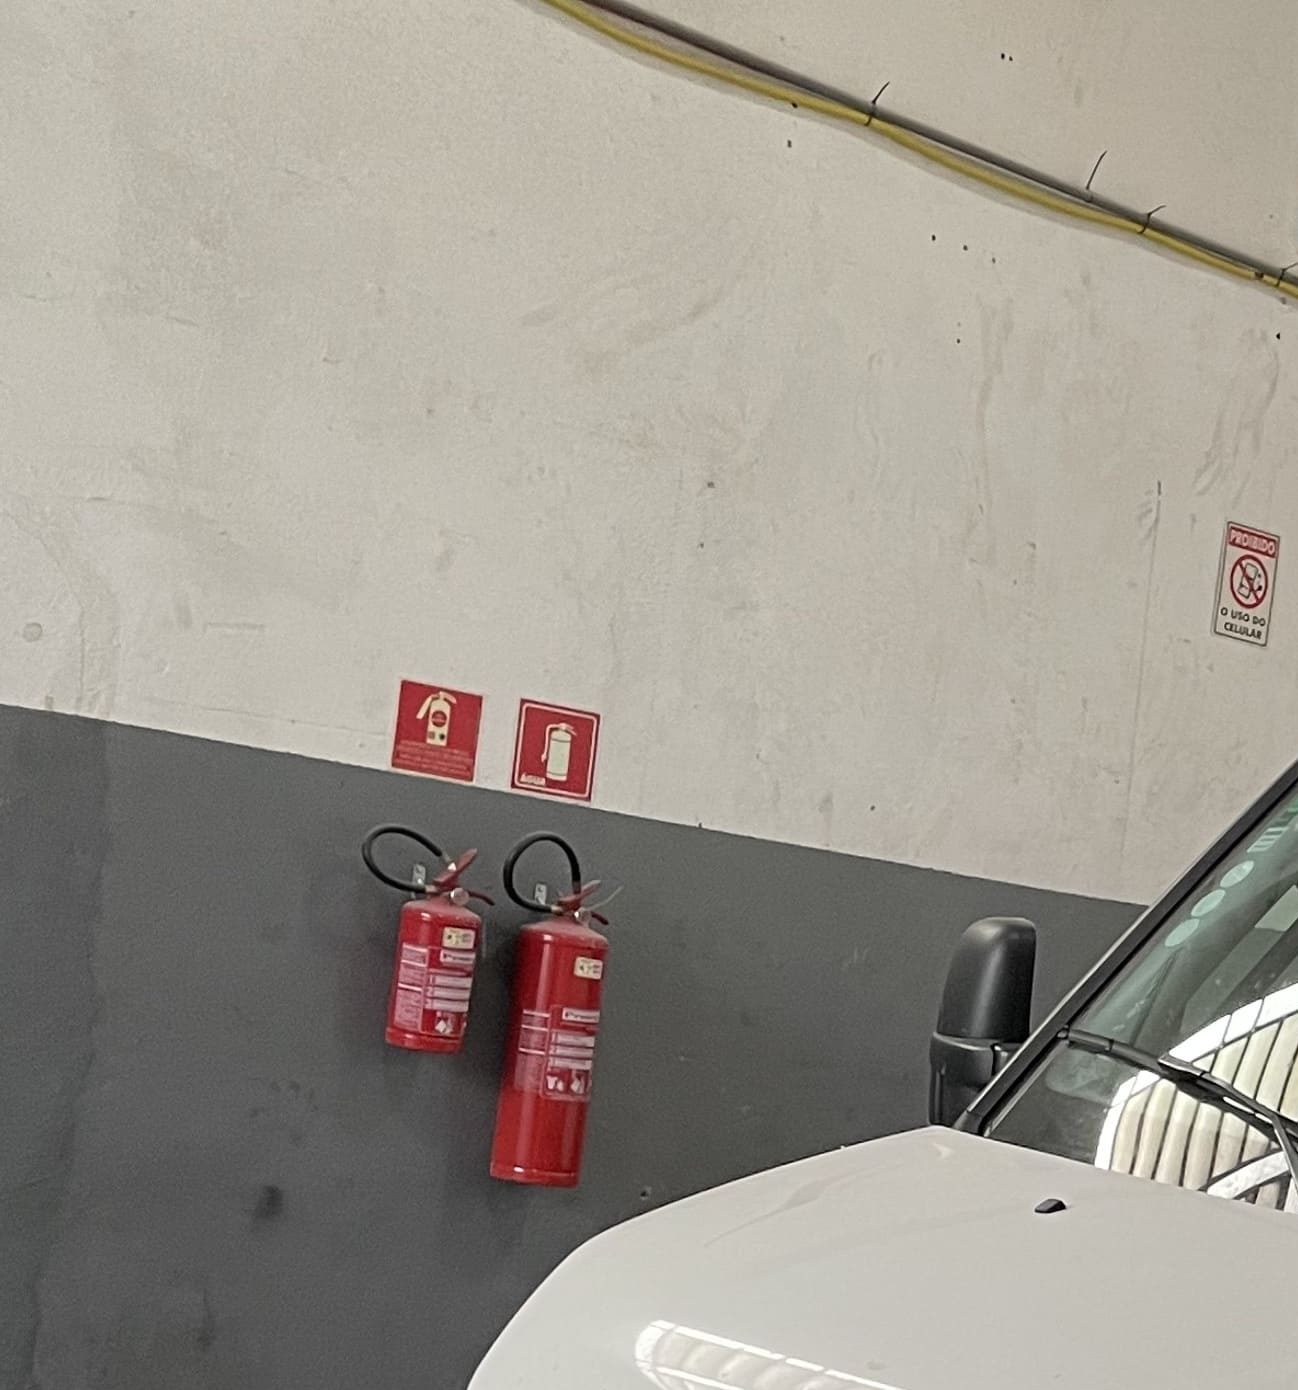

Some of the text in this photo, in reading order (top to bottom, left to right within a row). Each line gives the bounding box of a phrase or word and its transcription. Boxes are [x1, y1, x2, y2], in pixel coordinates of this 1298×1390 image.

[1230, 530, 1275, 554] PROIBIDO
[1220, 607, 1266, 626] O USO DO
[1224, 622, 1262, 639] CELULAR
